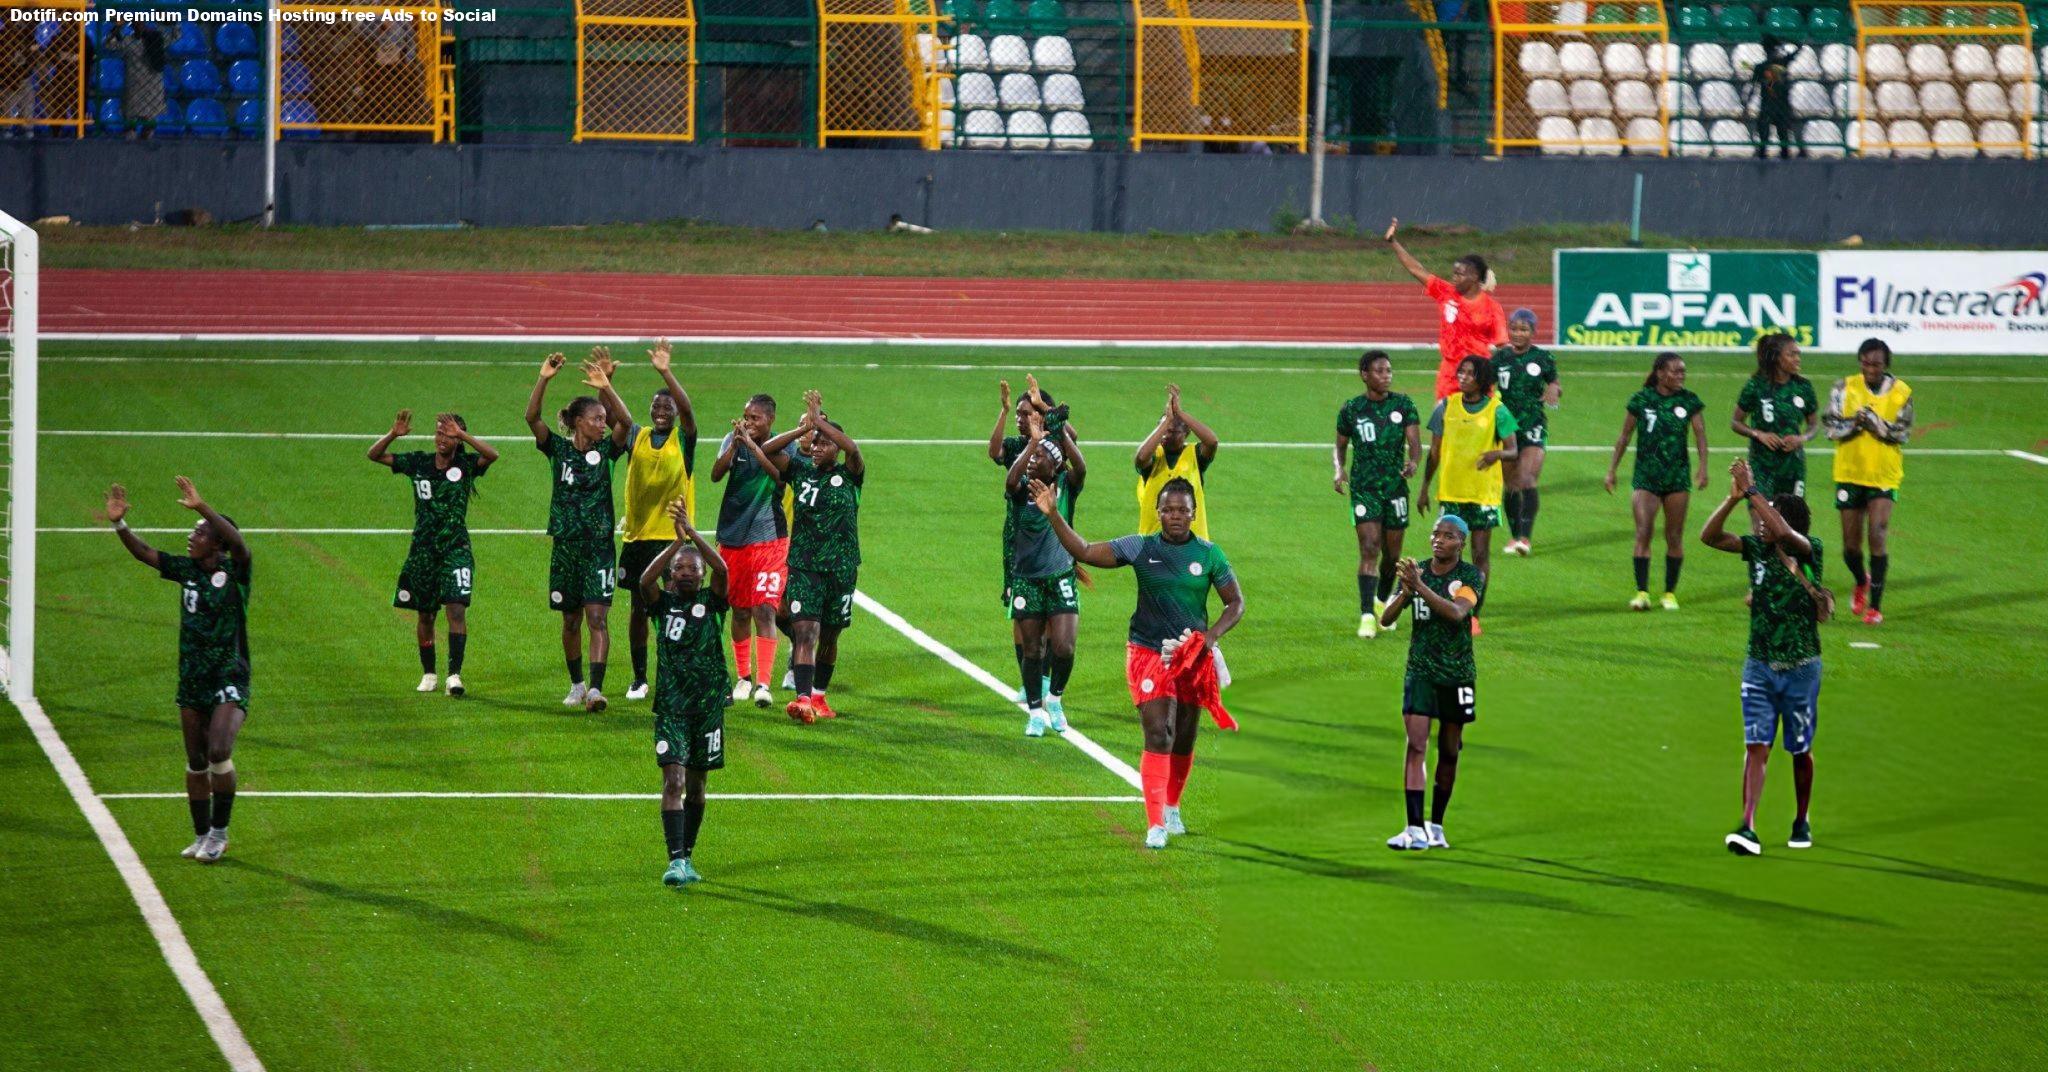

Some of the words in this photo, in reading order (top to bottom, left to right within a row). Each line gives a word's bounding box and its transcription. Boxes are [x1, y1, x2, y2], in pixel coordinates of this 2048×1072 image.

[1834, 276, 1876, 314] F1
[1583, 292, 1797, 328] APFAN
[1566, 323, 1644, 347] Super
[1648, 325, 1742, 347] League
[1834, 319, 1910, 333] Knowledge
[1356, 421, 1376, 442] 10
[1645, 413, 1657, 433] 7
[560, 461, 575, 486] 14
[414, 479, 433, 500] 19
[798, 481, 820, 507] 21
[1391, 496, 1408, 518] 10
[453, 567, 472, 588] 19
[598, 568, 615, 589] 14
[755, 571, 782, 592] 23
[183, 587, 199, 614] 13
[1412, 597, 1431, 621] 15
[665, 614, 687, 642] 18
[704, 728, 722, 754] 18
